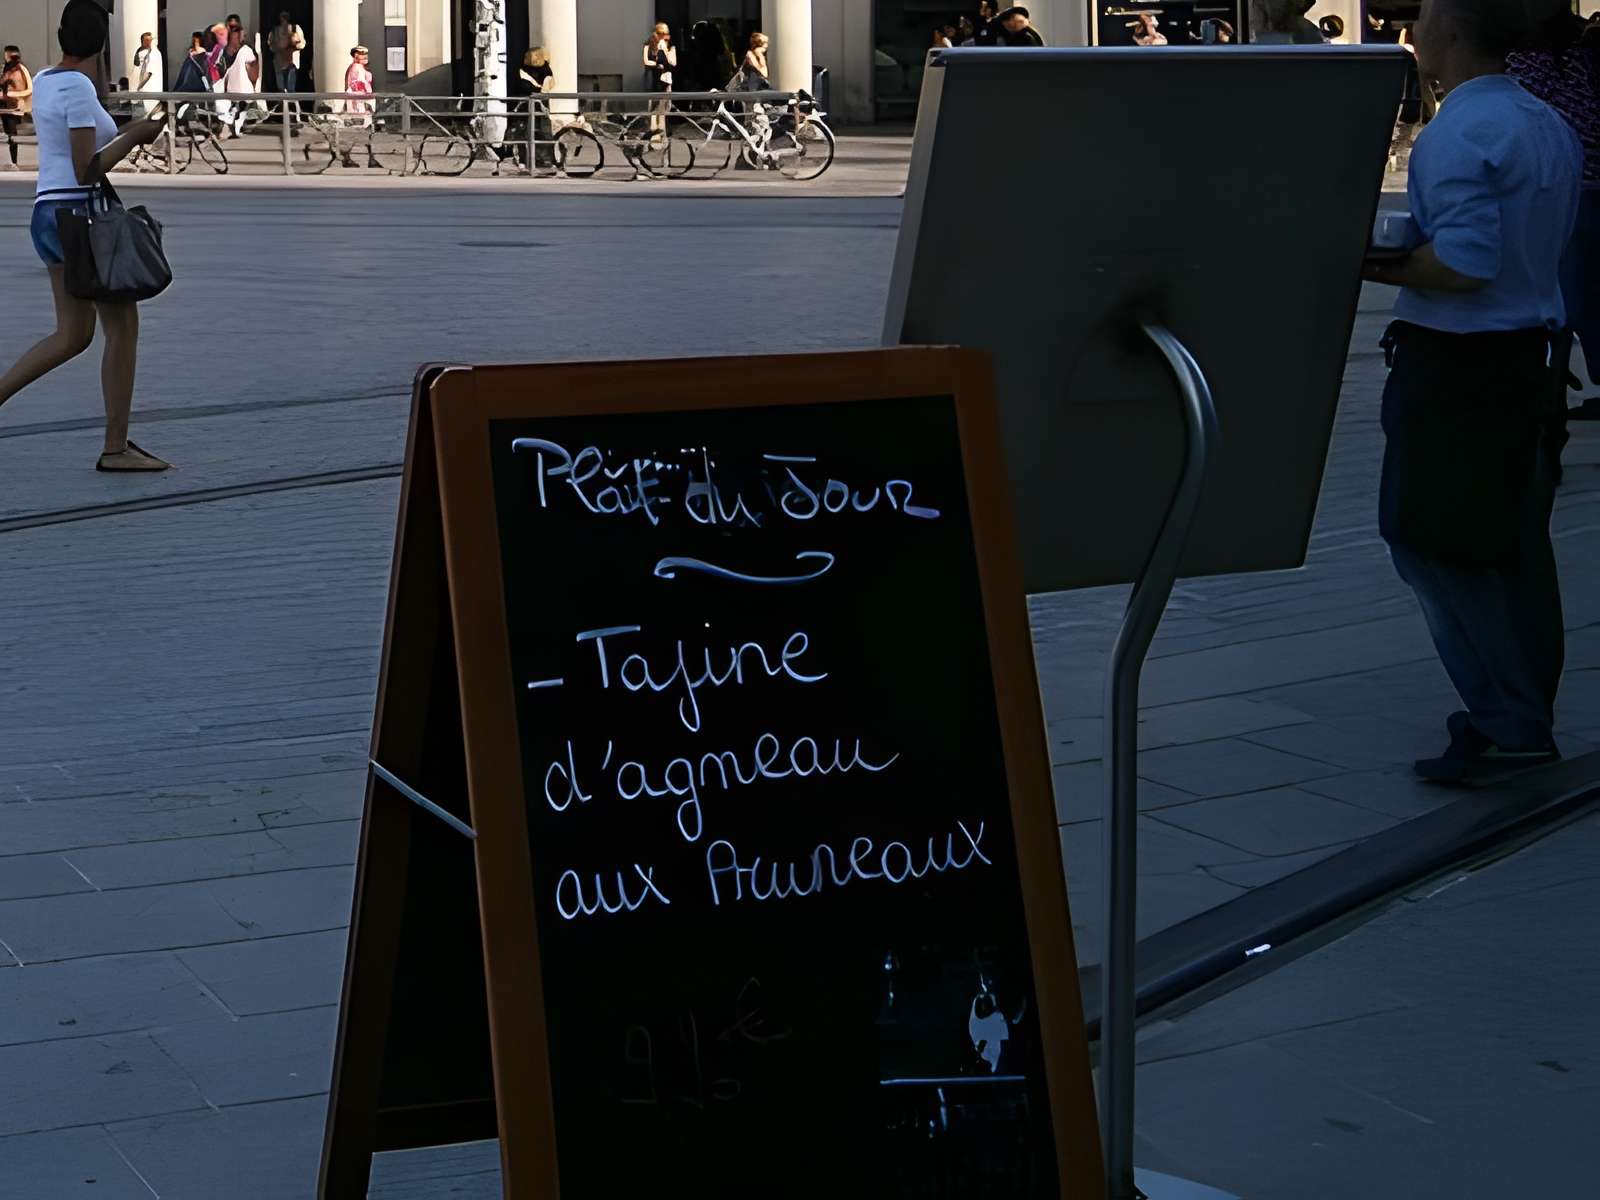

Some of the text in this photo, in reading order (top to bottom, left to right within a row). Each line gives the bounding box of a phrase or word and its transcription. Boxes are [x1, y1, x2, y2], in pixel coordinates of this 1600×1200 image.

[575, 622, 828, 732] Tajine
[544, 732, 900, 841] d'agneau
[555, 863, 671, 920] aux
